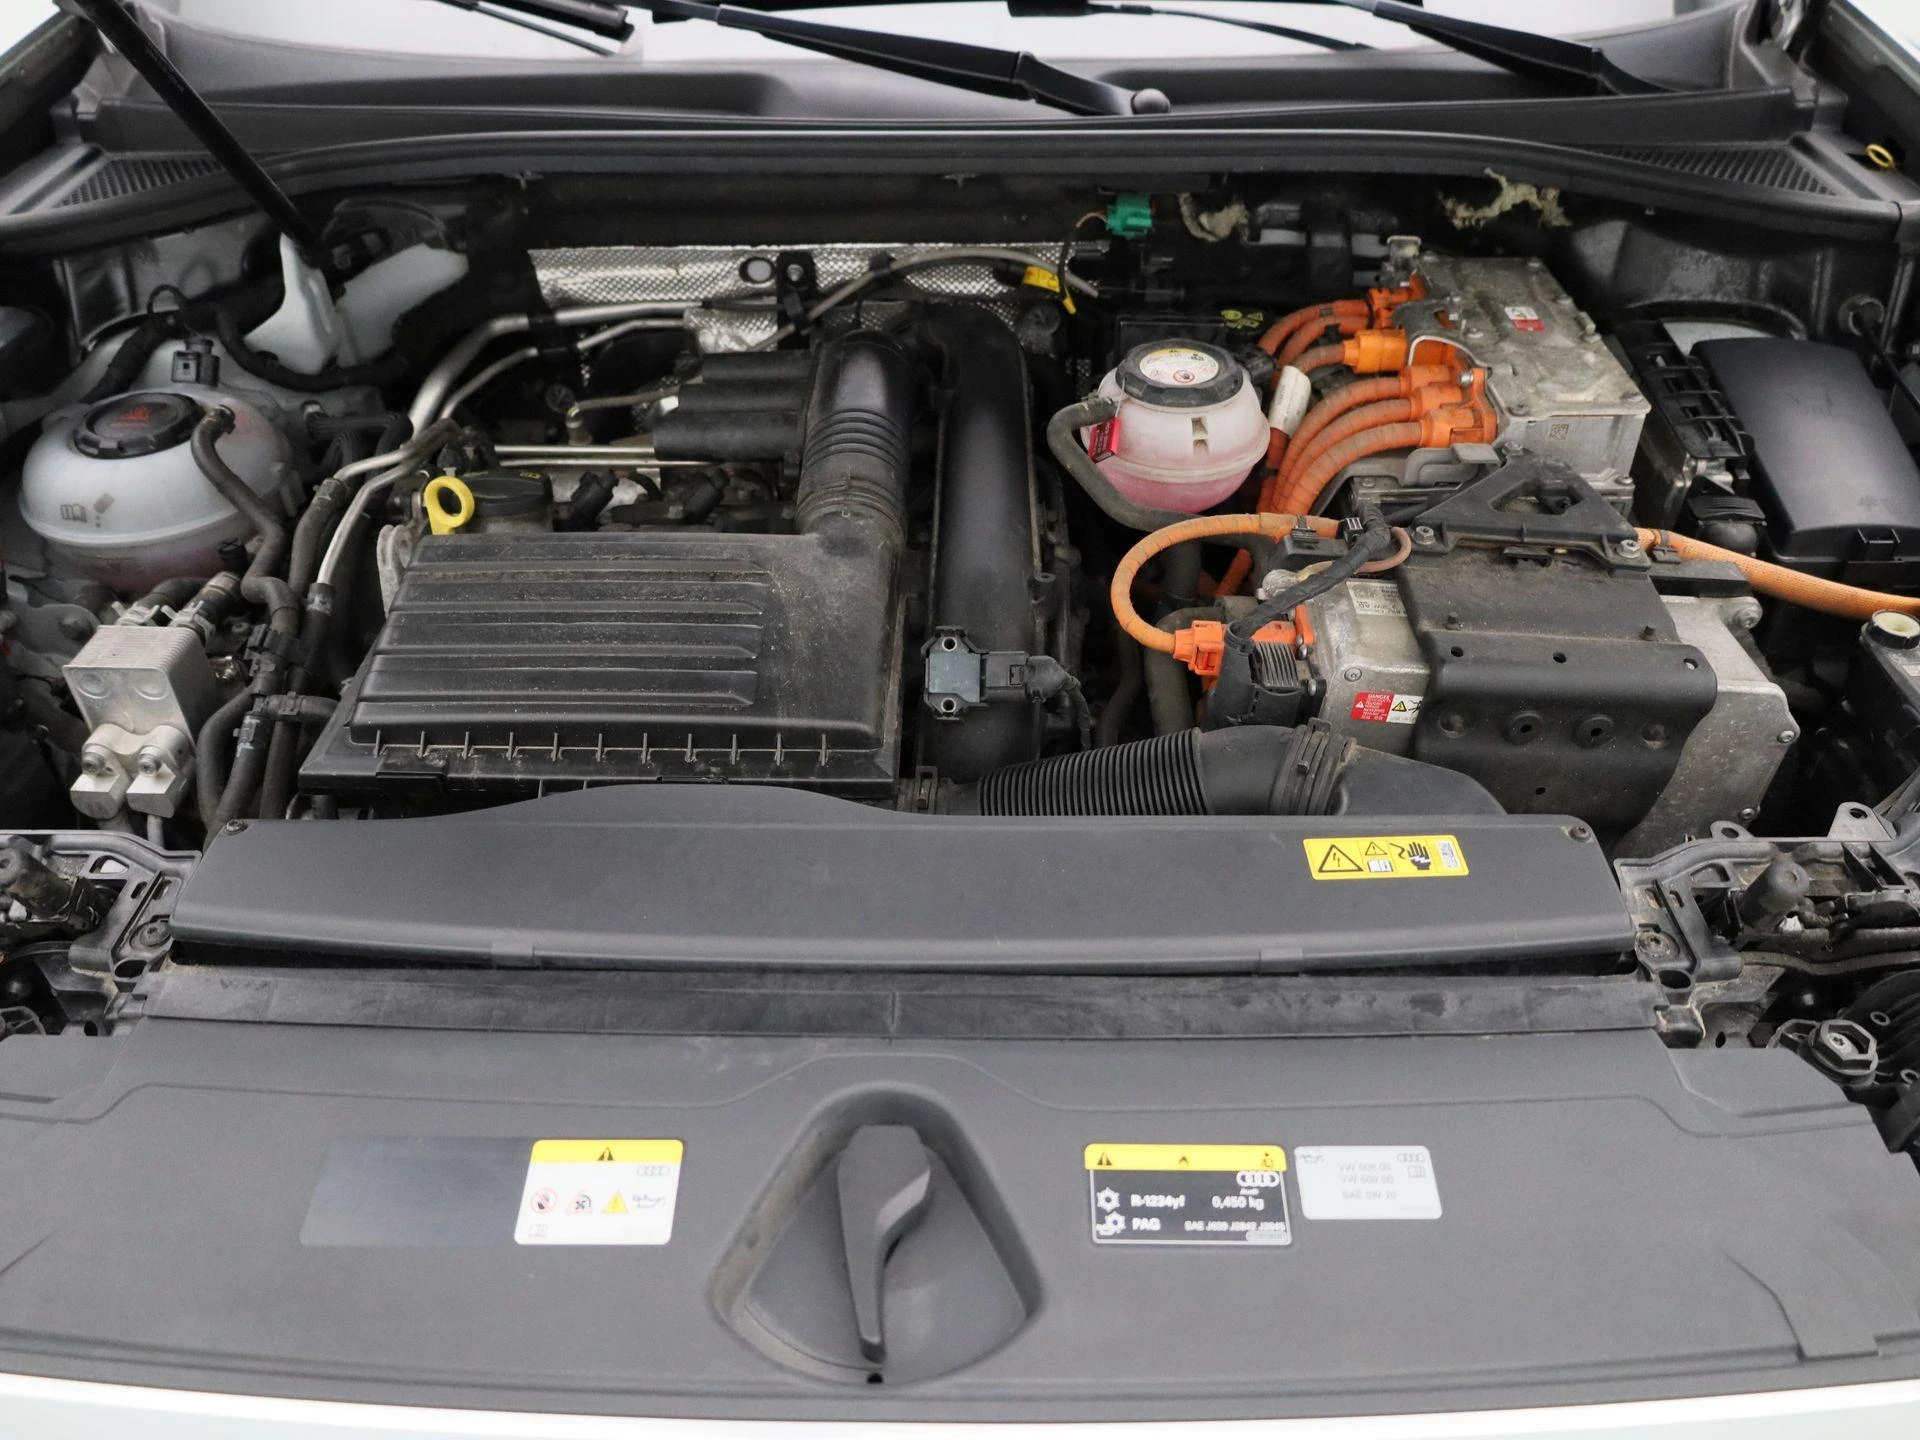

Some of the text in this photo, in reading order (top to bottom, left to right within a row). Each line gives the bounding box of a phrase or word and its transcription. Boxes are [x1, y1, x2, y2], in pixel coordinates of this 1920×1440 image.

[1130, 1194, 1265, 1211] R-1234yf 0,450 kg
[1131, 1217, 1161, 1232] PAG
[1184, 1220, 1205, 1232] SAE
